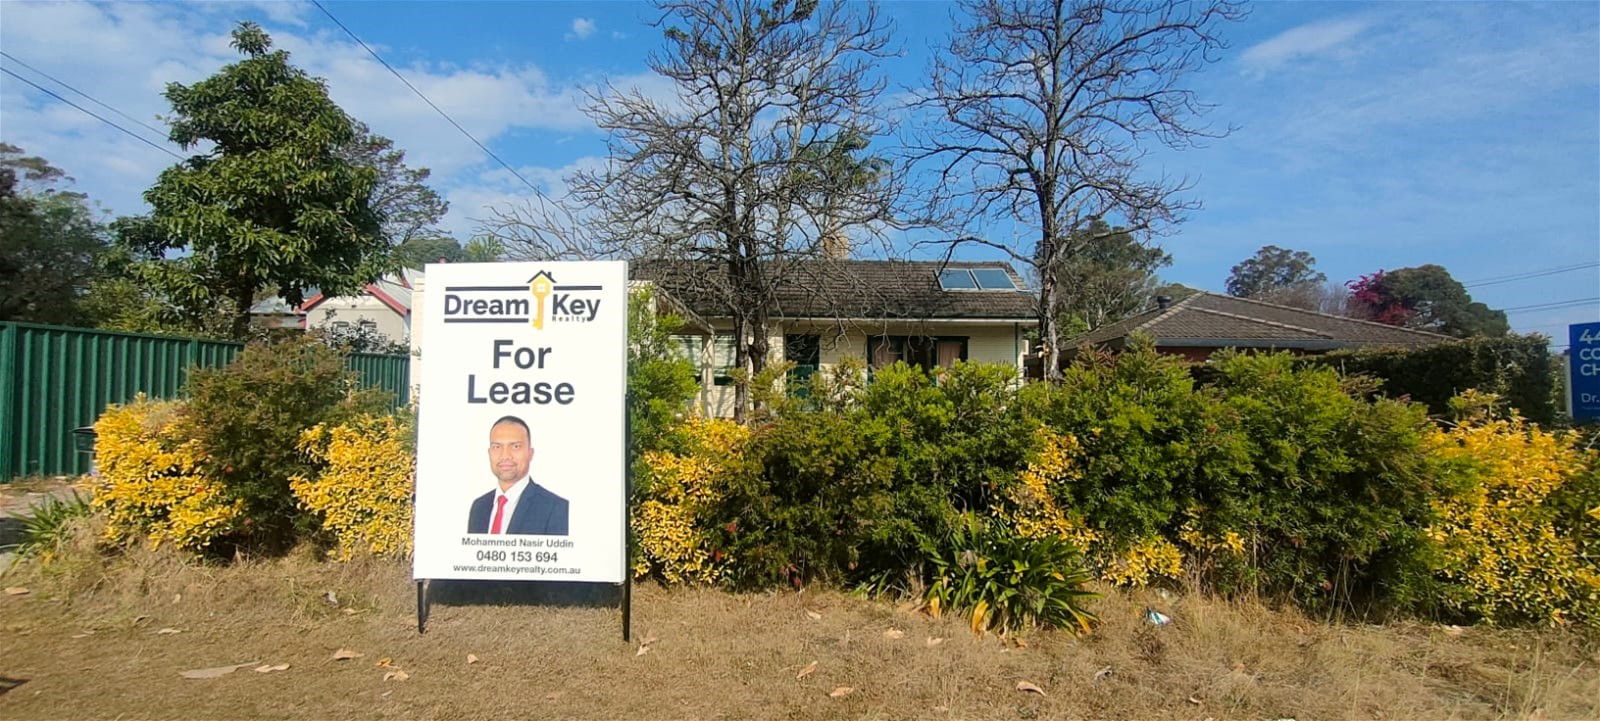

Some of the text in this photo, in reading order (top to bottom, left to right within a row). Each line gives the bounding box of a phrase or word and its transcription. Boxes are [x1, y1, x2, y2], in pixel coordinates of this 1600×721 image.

[444, 293, 601, 322] Dream Key
[493, 339, 552, 370] For
[467, 374, 575, 405] Lease
[1581, 393, 1600, 403] Dr.
[461, 537, 574, 549] Mohammed Nasir Uddin
[476, 550, 558, 563] 0480 153 694
[453, 564, 581, 575] www.dreamkeyrealty.com.au
